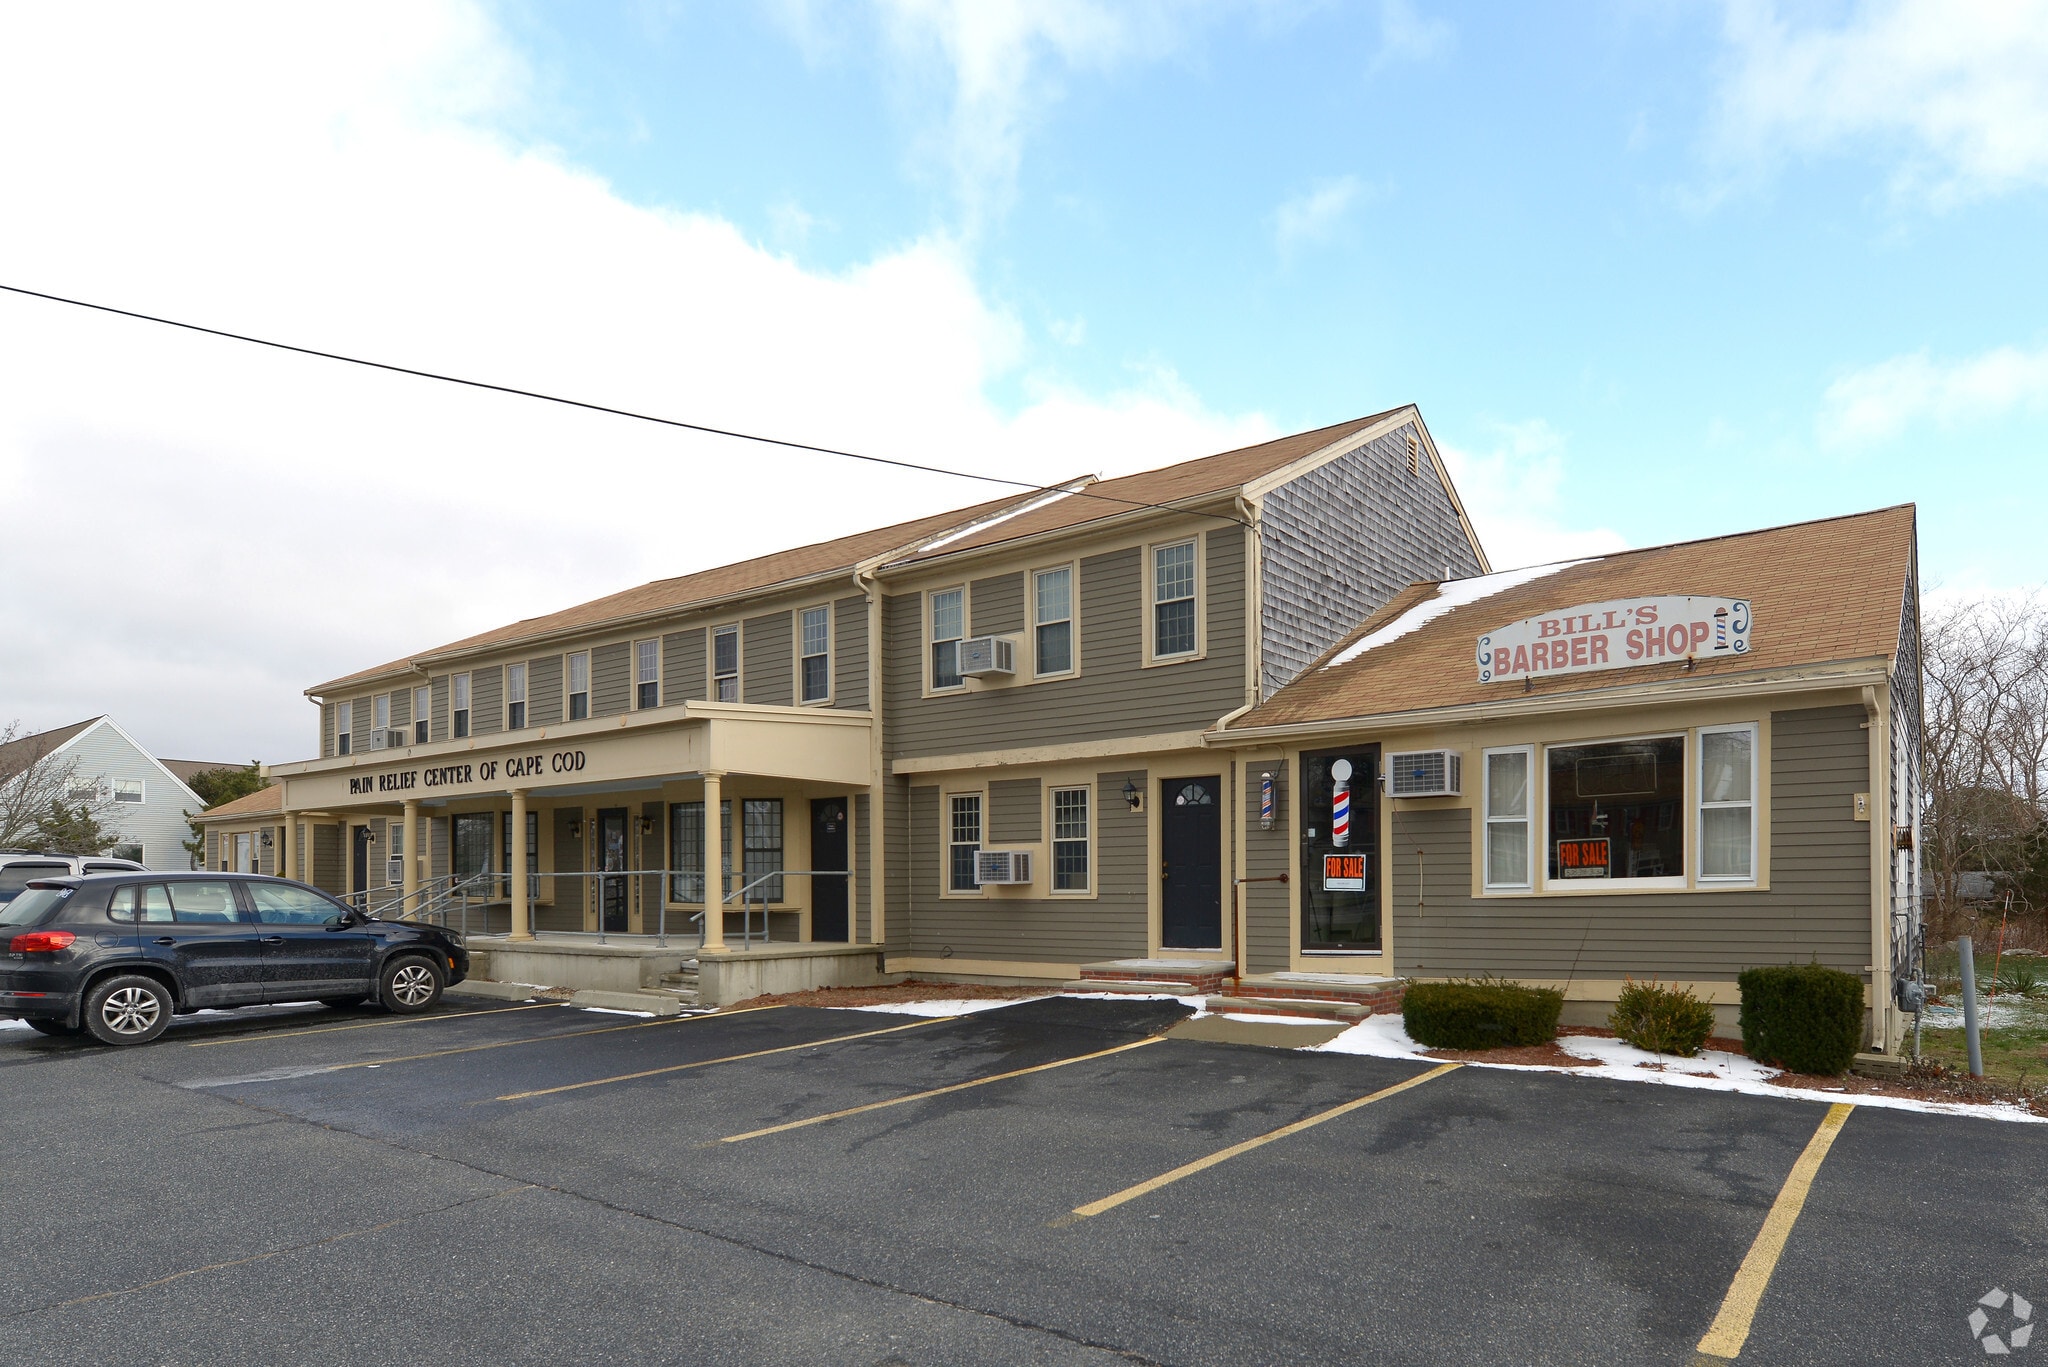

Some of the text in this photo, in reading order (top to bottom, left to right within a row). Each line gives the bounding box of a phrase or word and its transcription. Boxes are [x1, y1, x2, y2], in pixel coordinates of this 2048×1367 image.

[1538, 605, 1658, 638] BILL'S
[1494, 621, 1709, 676] BARBER SHOP
[350, 751, 586, 794] PAIN RELIEF CENTER OF CAPE COD
[1326, 857, 1363, 877] FOR SALE
[1561, 841, 1607, 866] FOR SALE
